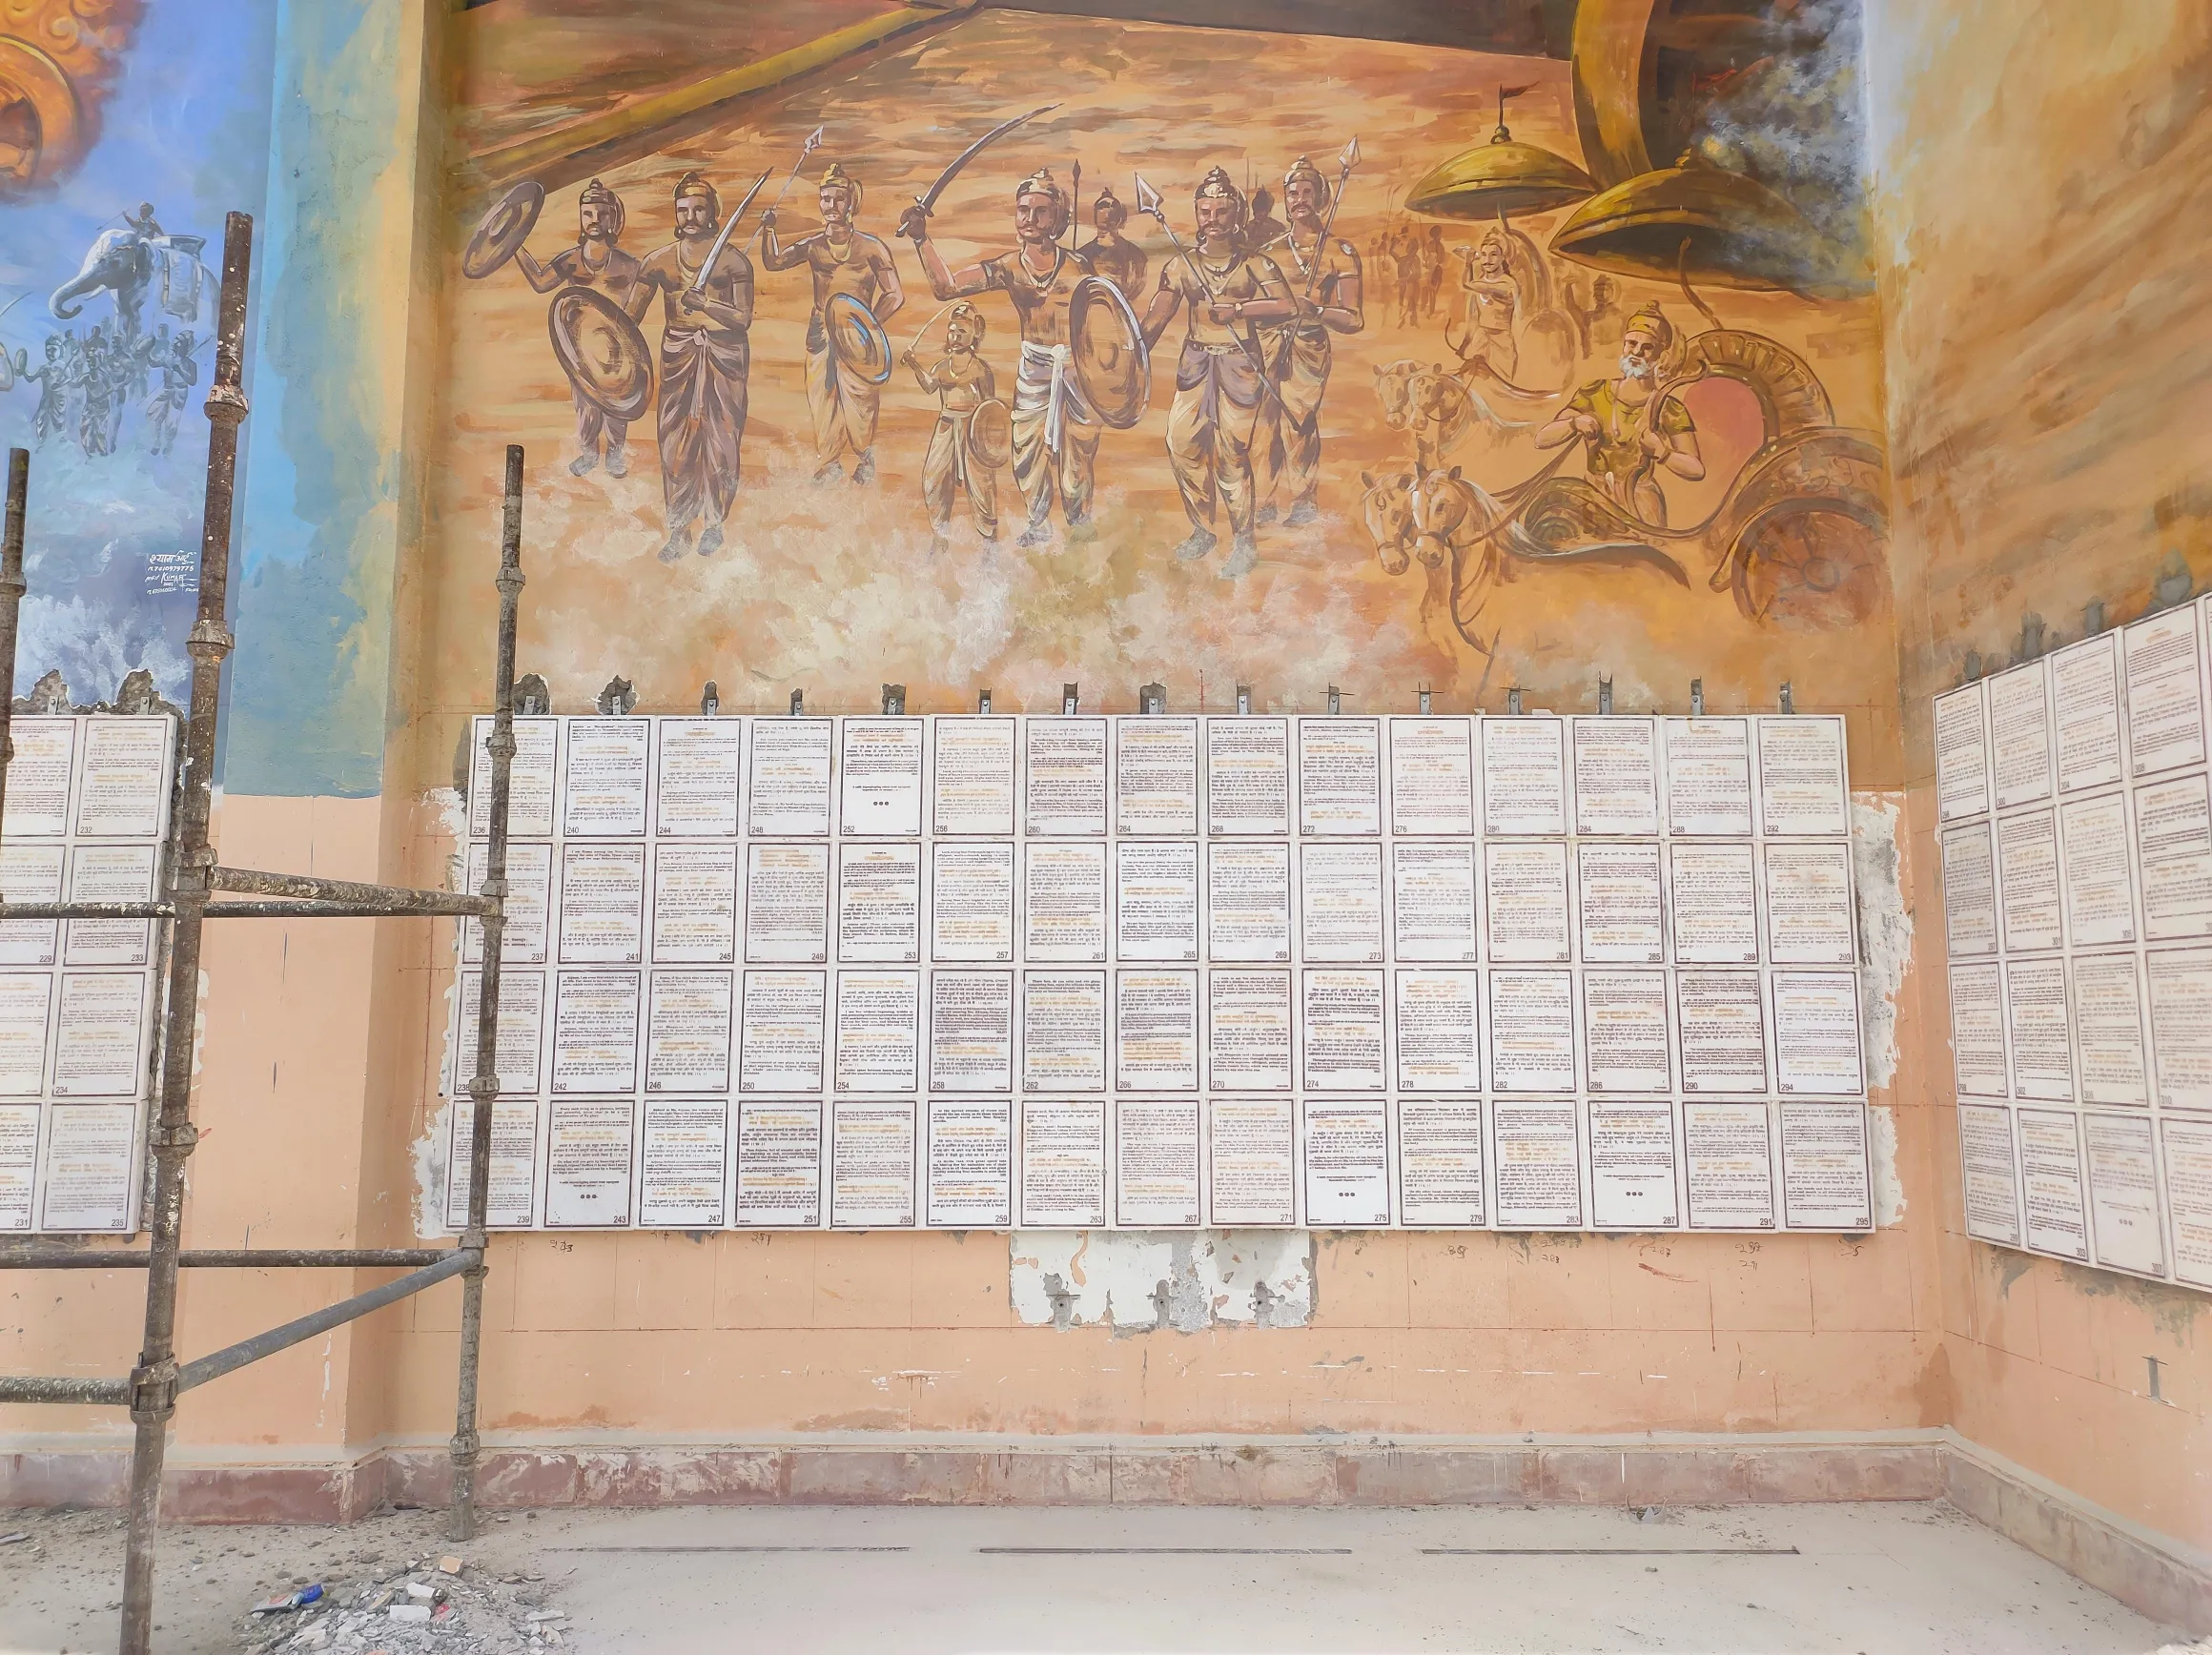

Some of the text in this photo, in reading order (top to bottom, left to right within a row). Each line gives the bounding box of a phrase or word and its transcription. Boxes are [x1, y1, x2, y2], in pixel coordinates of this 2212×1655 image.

[2061, 781, 2070, 791] 304
[80, 826, 92, 834] 232
[2052, 937, 2060, 945] 301
[2017, 1087, 2026, 1095] 302
[2161, 1095, 2172, 1105] 310
[2076, 1248, 2085, 1257] 303
[2151, 1263, 2162, 1273] 307
